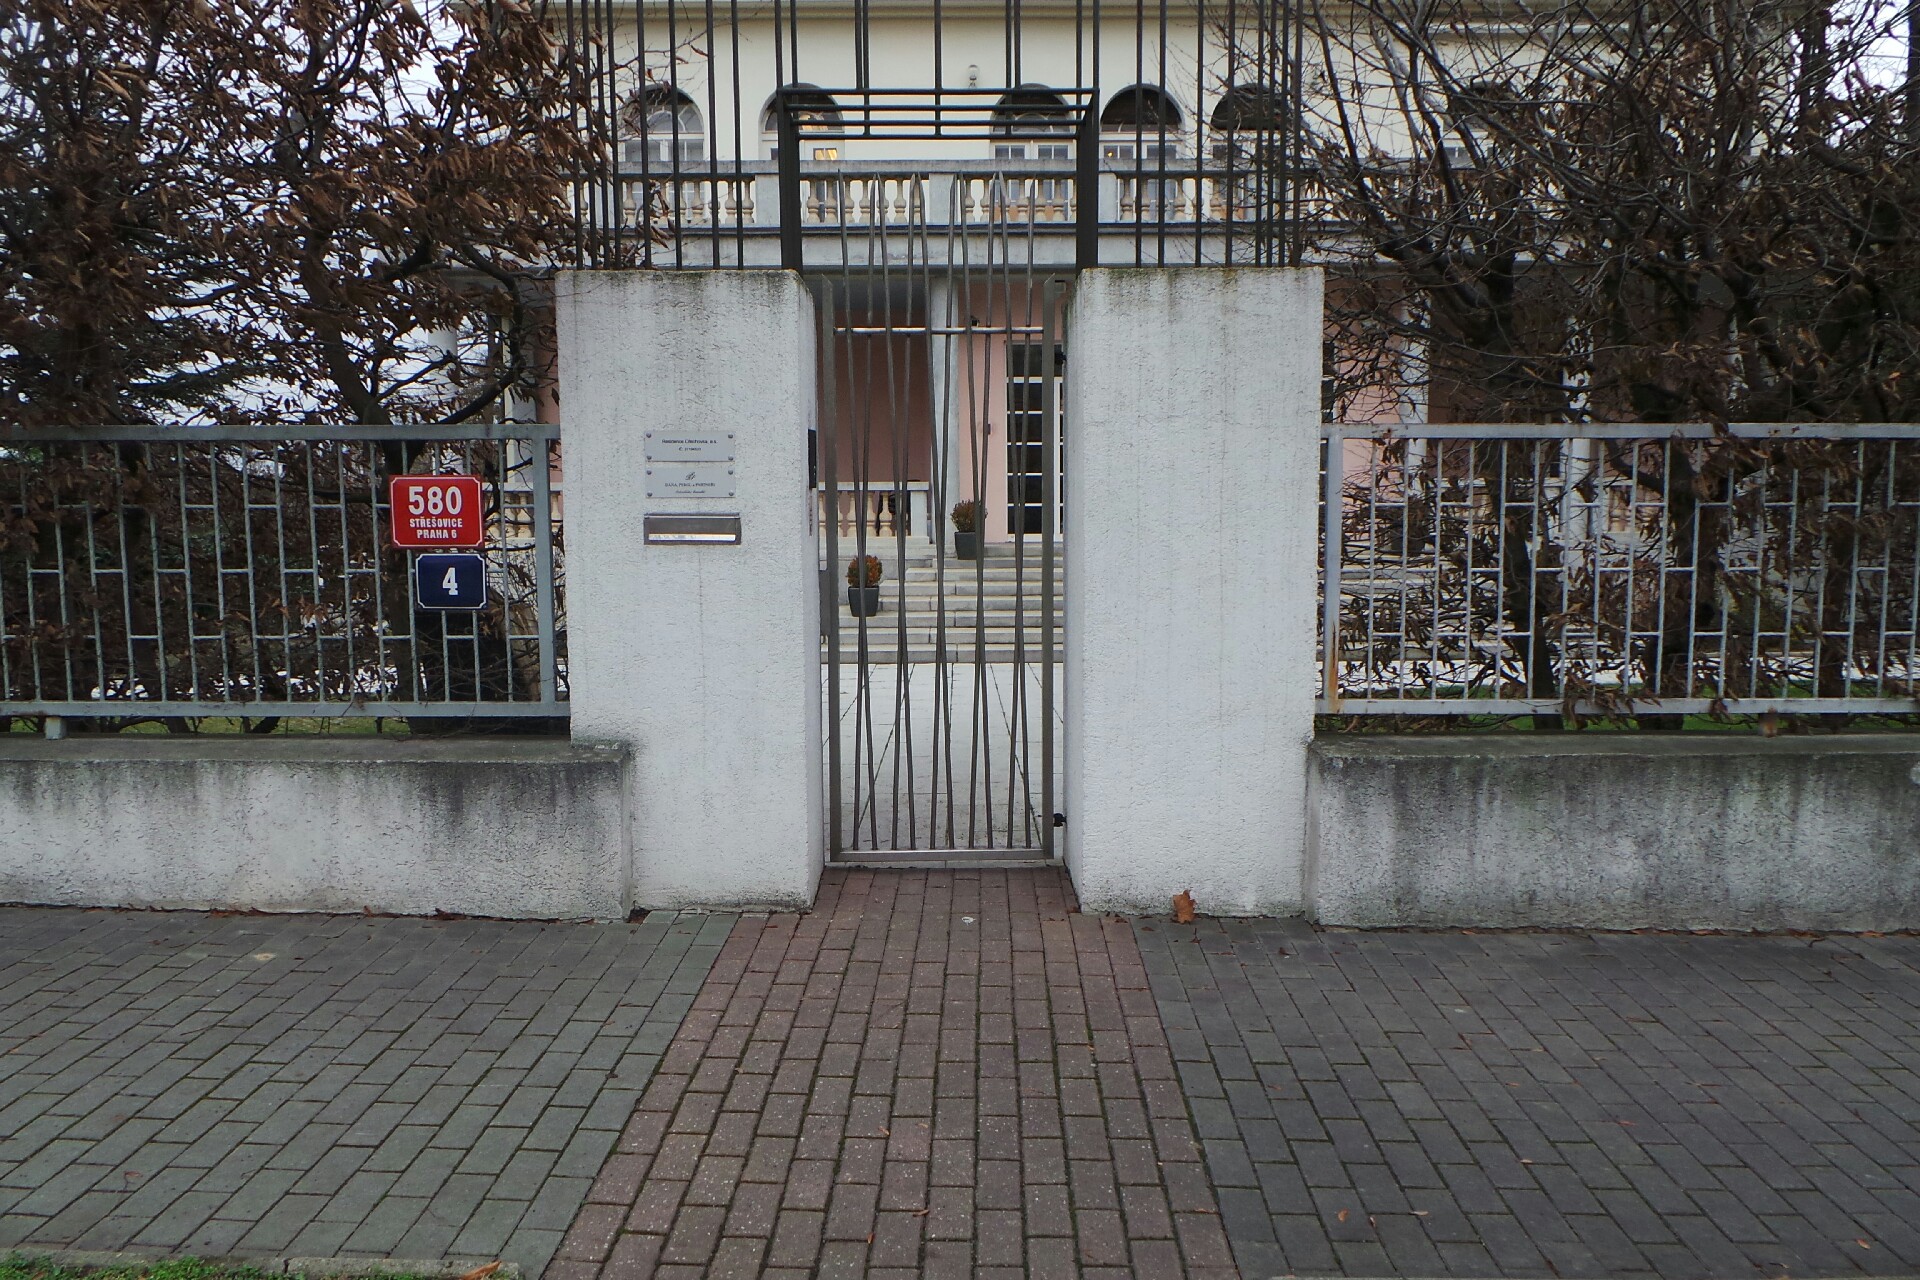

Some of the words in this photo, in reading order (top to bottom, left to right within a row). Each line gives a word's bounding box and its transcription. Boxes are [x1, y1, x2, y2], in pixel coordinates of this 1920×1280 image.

[408, 486, 462, 515] 580
[409, 516, 463, 528] STŘEŠOVICE
[417, 529, 449, 539] PRAHA
[451, 530, 458, 539] 6
[442, 567, 459, 596] 4
